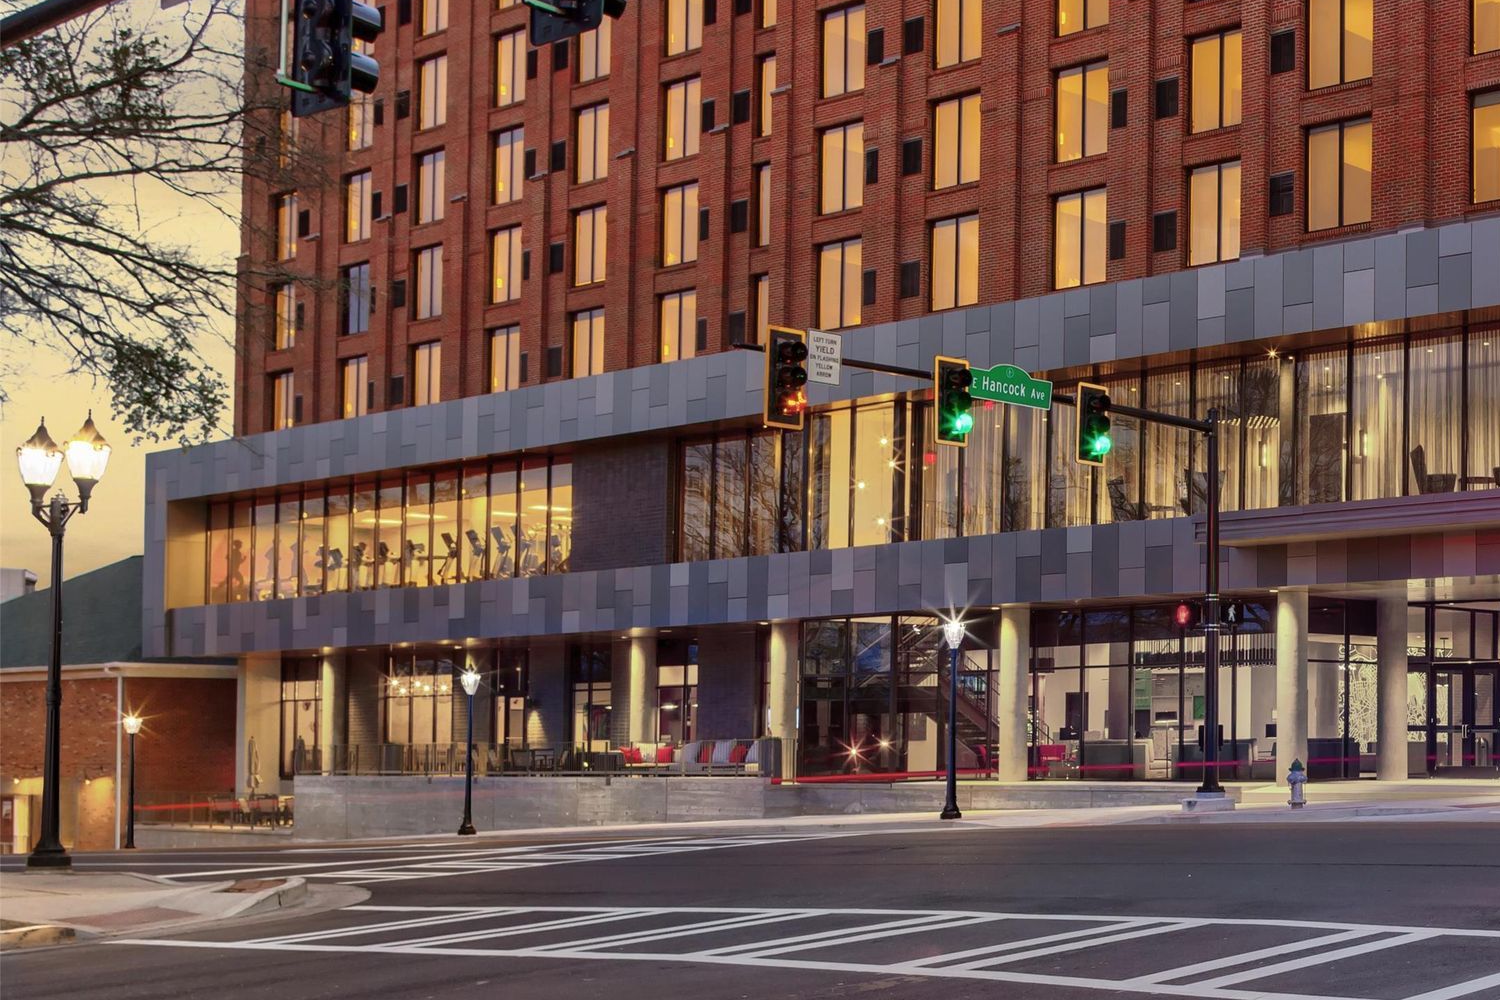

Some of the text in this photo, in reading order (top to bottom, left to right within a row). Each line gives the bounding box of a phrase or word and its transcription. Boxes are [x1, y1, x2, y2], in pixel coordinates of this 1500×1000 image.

[816, 345, 834, 354] YIELD
[972, 376, 1045, 400] E Hancock Ave
